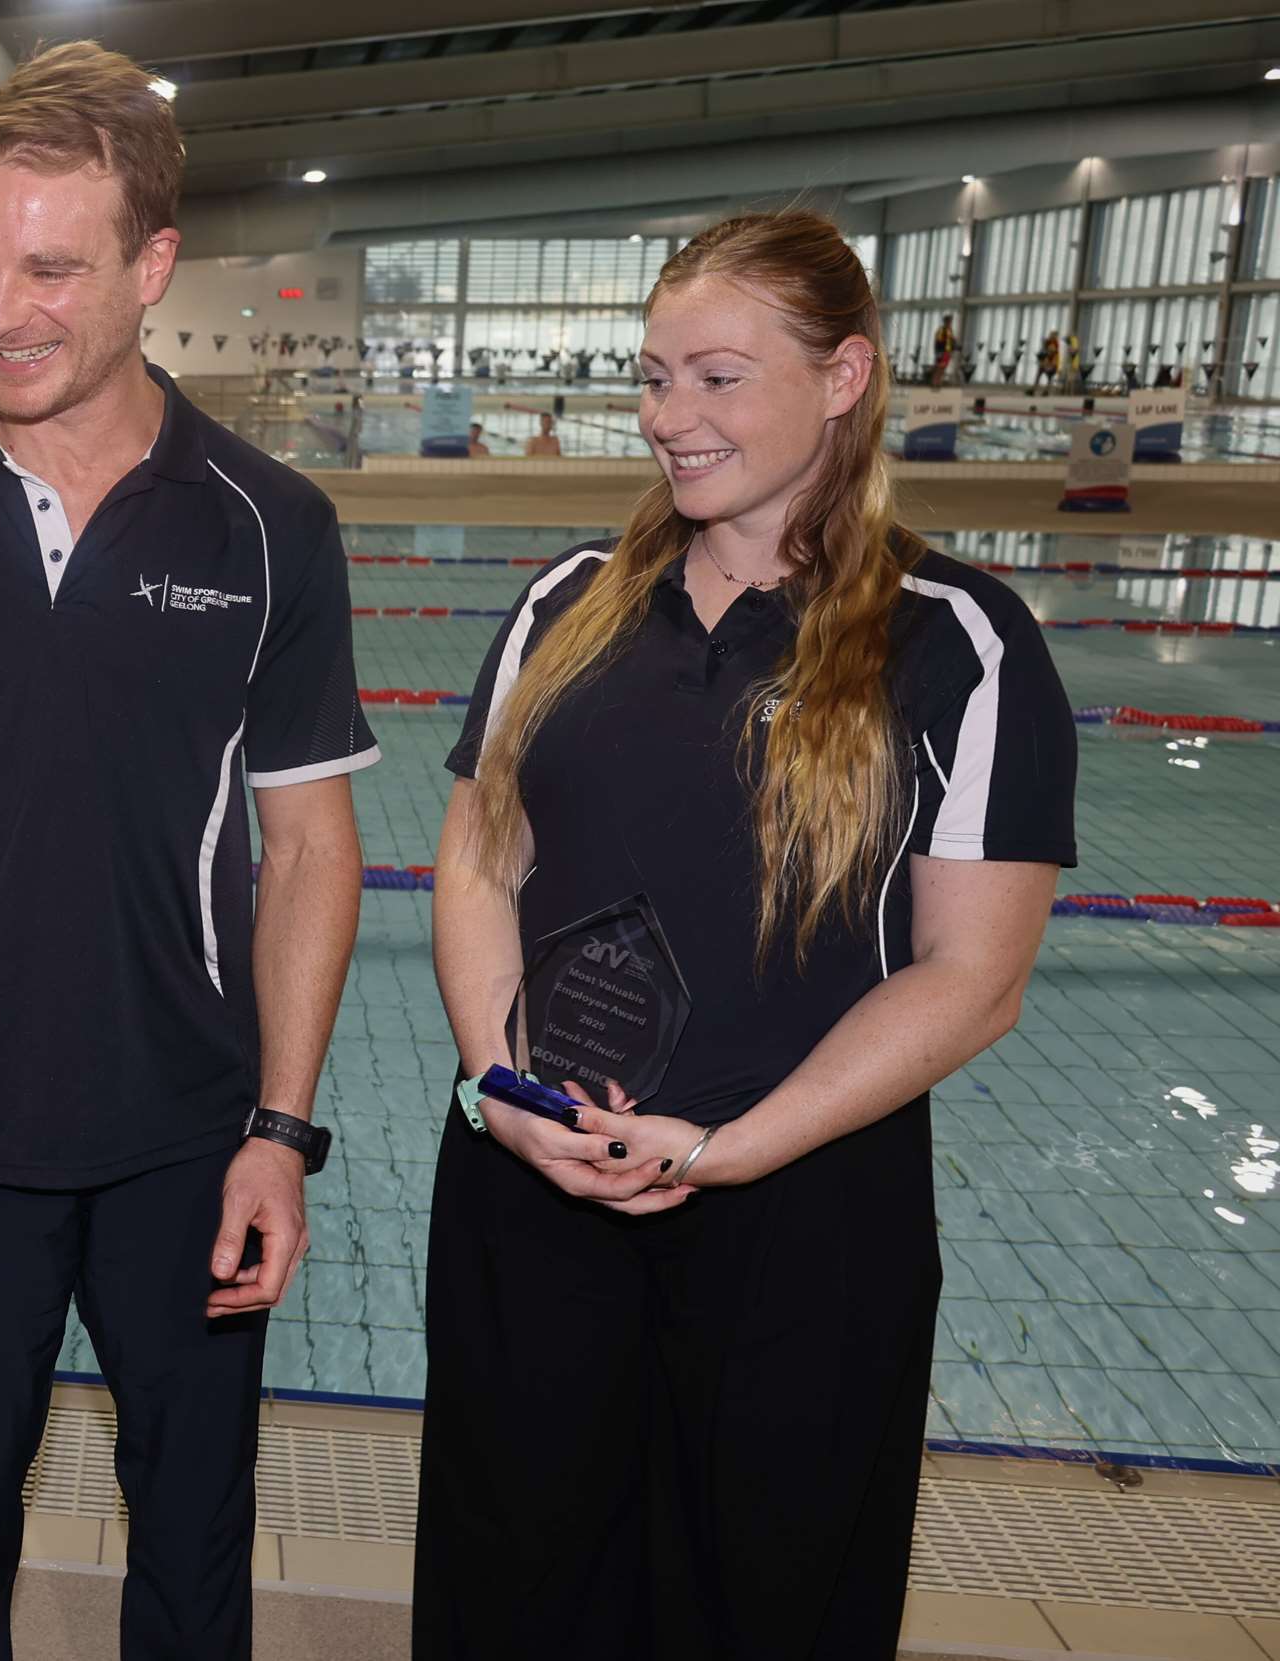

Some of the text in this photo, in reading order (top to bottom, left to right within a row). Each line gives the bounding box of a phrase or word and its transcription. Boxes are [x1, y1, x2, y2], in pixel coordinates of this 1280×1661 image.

[1135, 404, 1177, 415] LAP LANE
[170, 592, 229, 608] CITY OF GREATER
[171, 584, 192, 595] SWIM
[193, 588, 219, 597] SPORT
[222, 593, 253, 603] LEISURE
[169, 600, 207, 612] GEELONG
[568, 967, 646, 1004] Most Valuable
[554, 982, 647, 1026] Employee Award
[578, 1014, 607, 1031] 2025
[545, 1022, 626, 1062] Sarah Rindel
[531, 1046, 576, 1071] BODY
